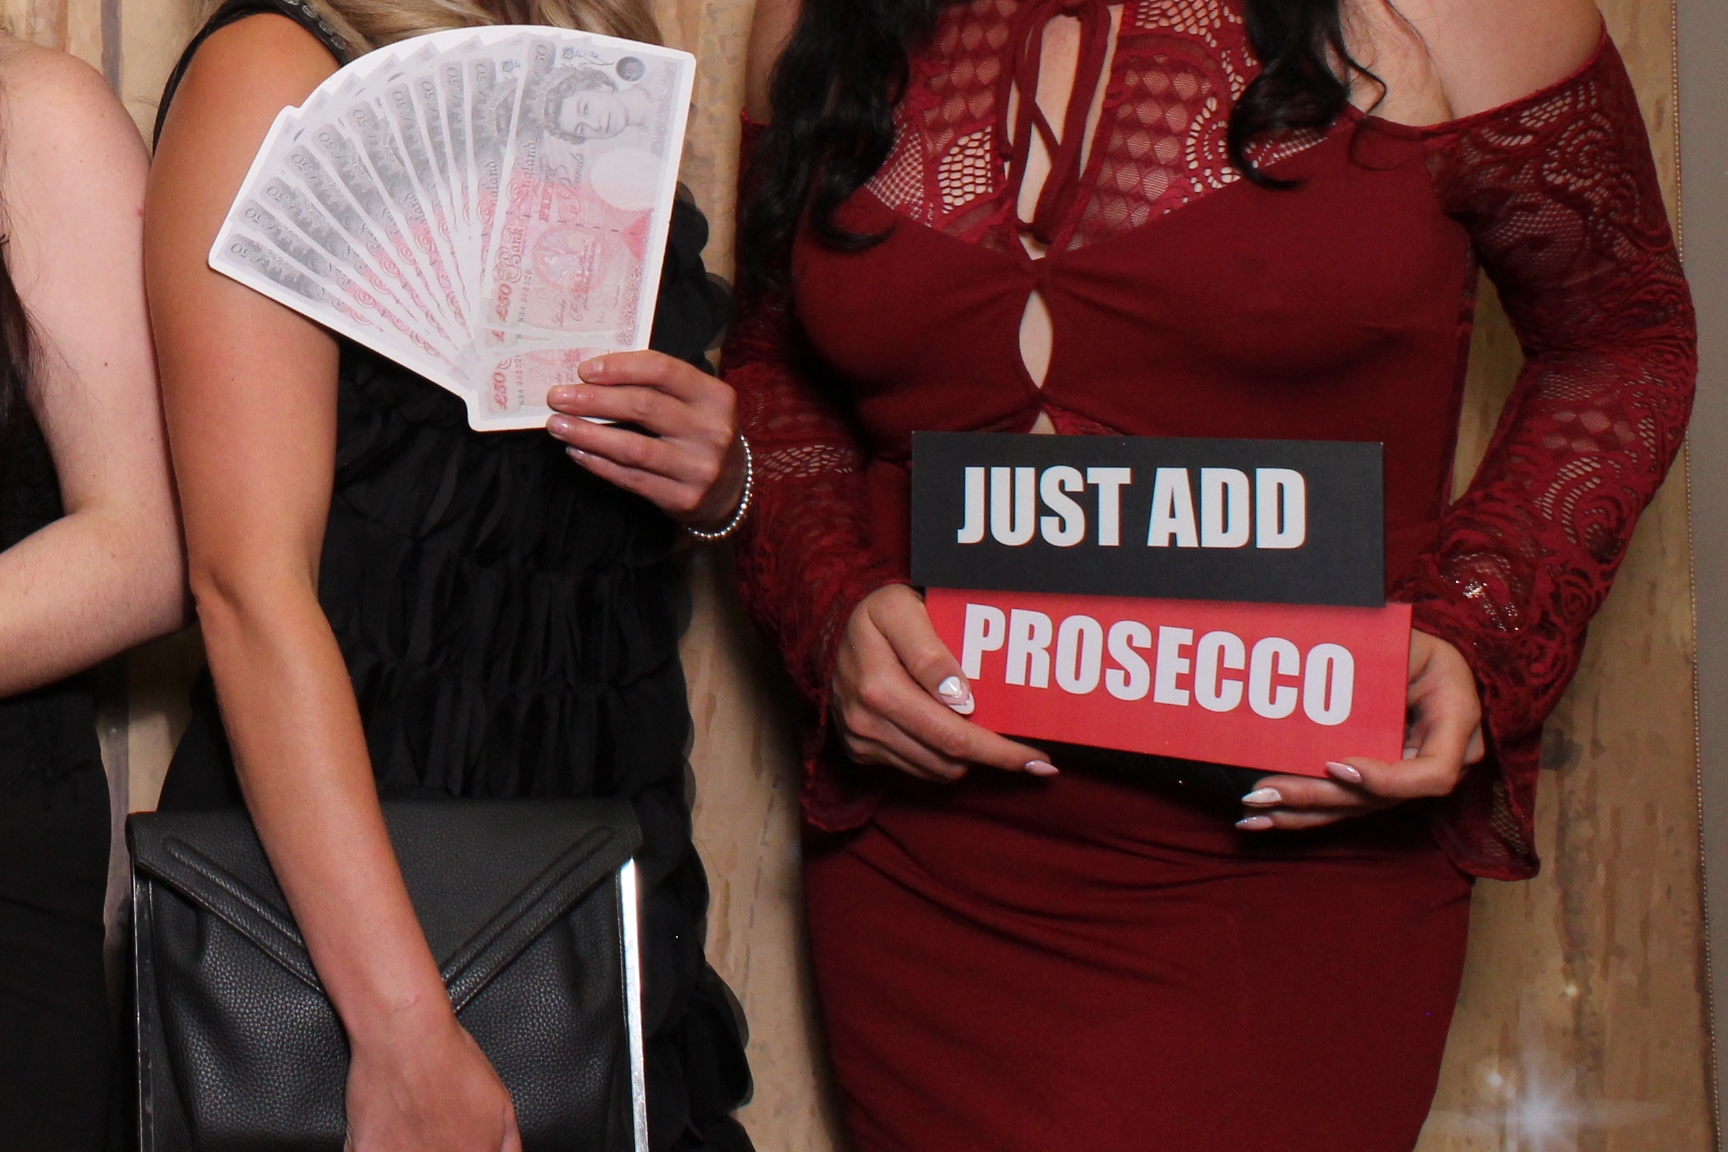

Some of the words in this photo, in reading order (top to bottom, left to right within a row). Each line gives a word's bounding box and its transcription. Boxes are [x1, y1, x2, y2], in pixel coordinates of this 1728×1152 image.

[507, 142, 537, 202] England
[538, 166, 556, 222] FIFTY
[493, 228, 523, 282] Bank
[495, 283, 512, 322] £50
[492, 371, 507, 410] £50
[957, 465, 1131, 547] JUST
[1147, 467, 1307, 550] ADD
[961, 603, 1355, 727] PROSECCO
